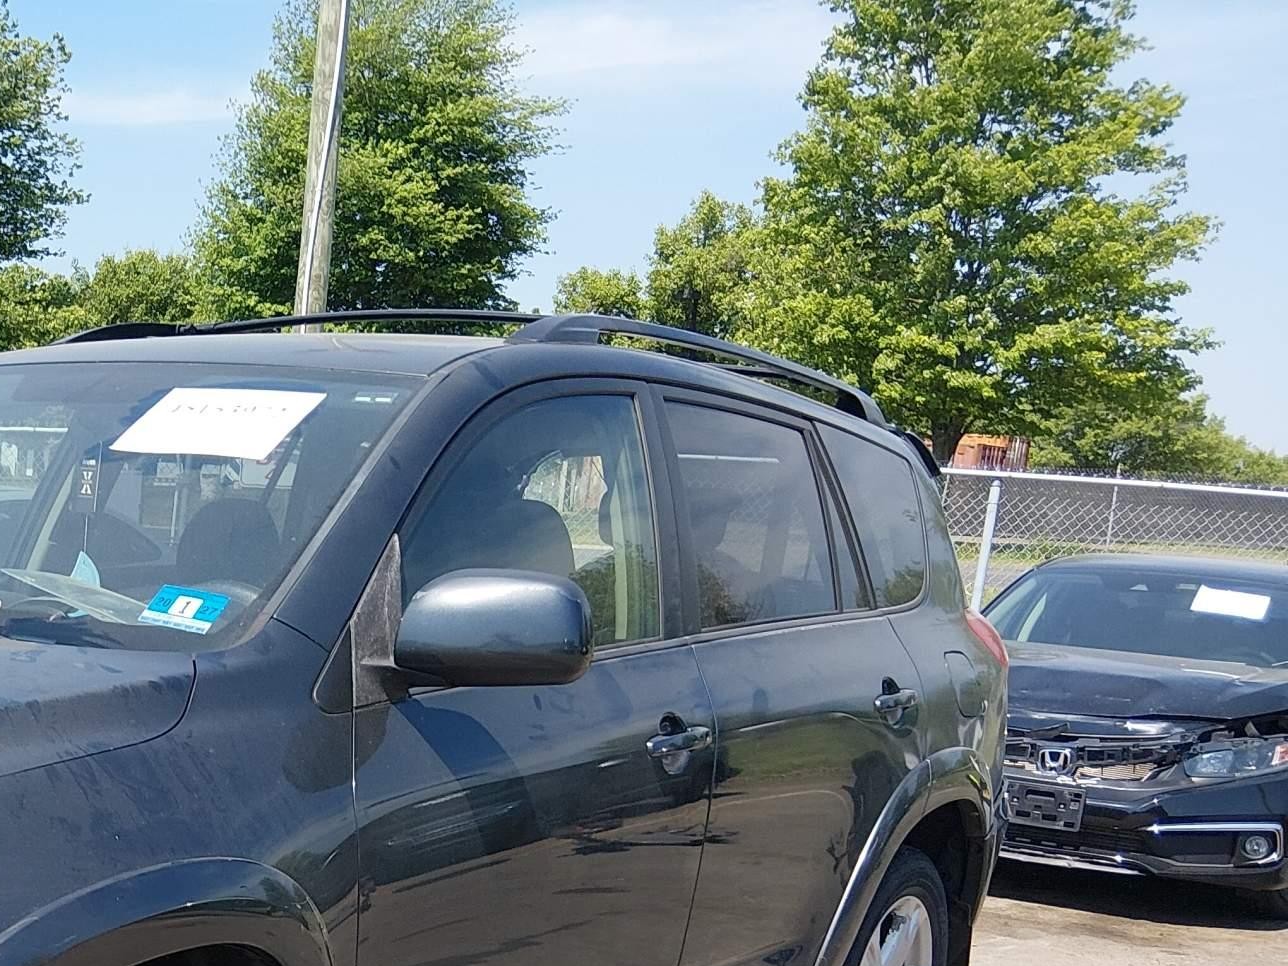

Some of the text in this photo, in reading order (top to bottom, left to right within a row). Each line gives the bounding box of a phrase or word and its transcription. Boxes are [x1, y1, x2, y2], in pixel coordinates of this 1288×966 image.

[155, 596, 218, 616] 20 1 27
